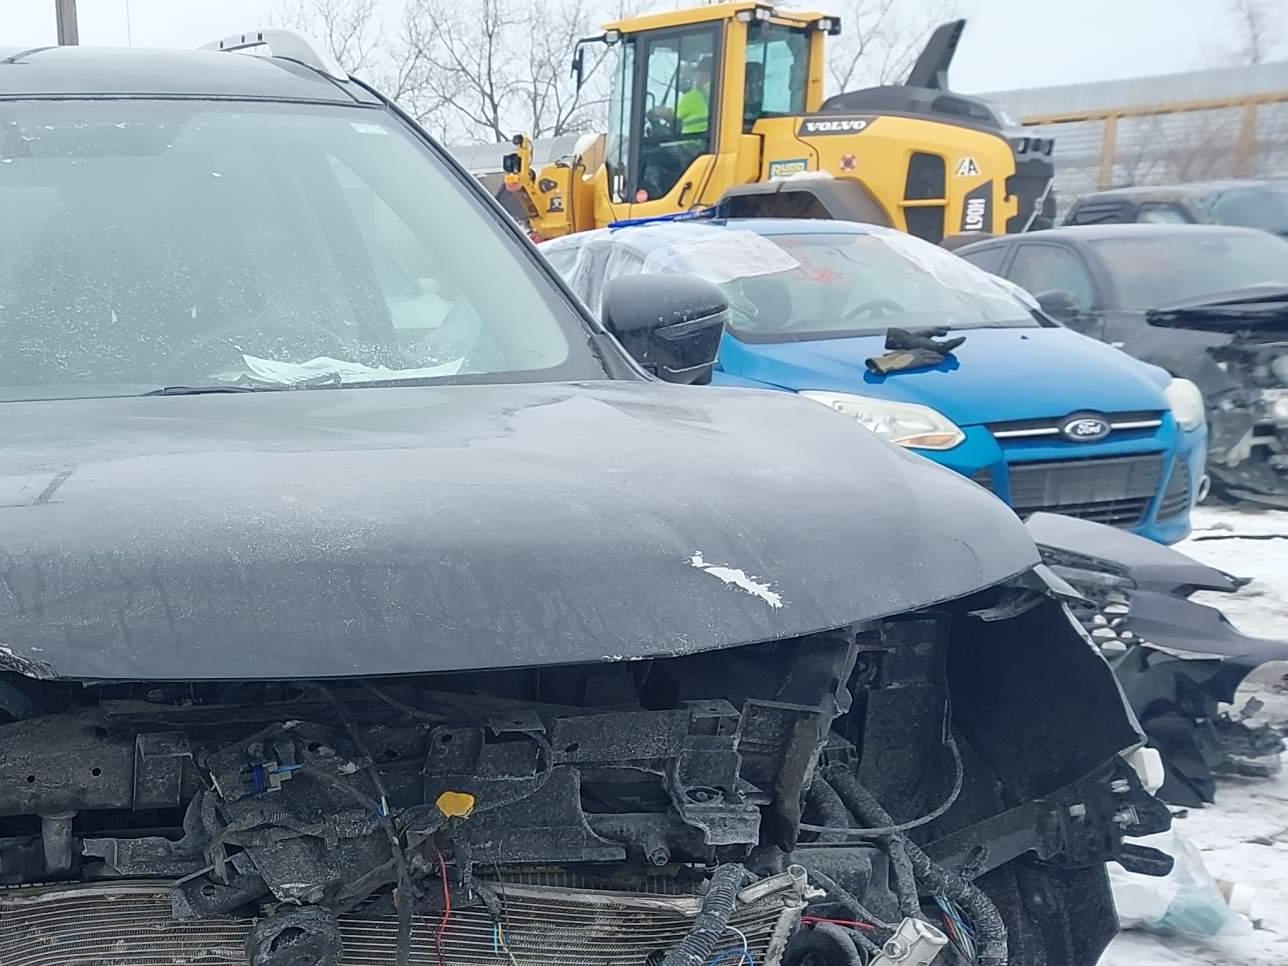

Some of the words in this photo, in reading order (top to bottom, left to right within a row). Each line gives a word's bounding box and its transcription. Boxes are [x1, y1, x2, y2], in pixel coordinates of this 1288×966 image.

[806, 120, 866, 132] VOLVO
[964, 198, 986, 230] L90H
[1077, 422, 1102, 434] Ford
